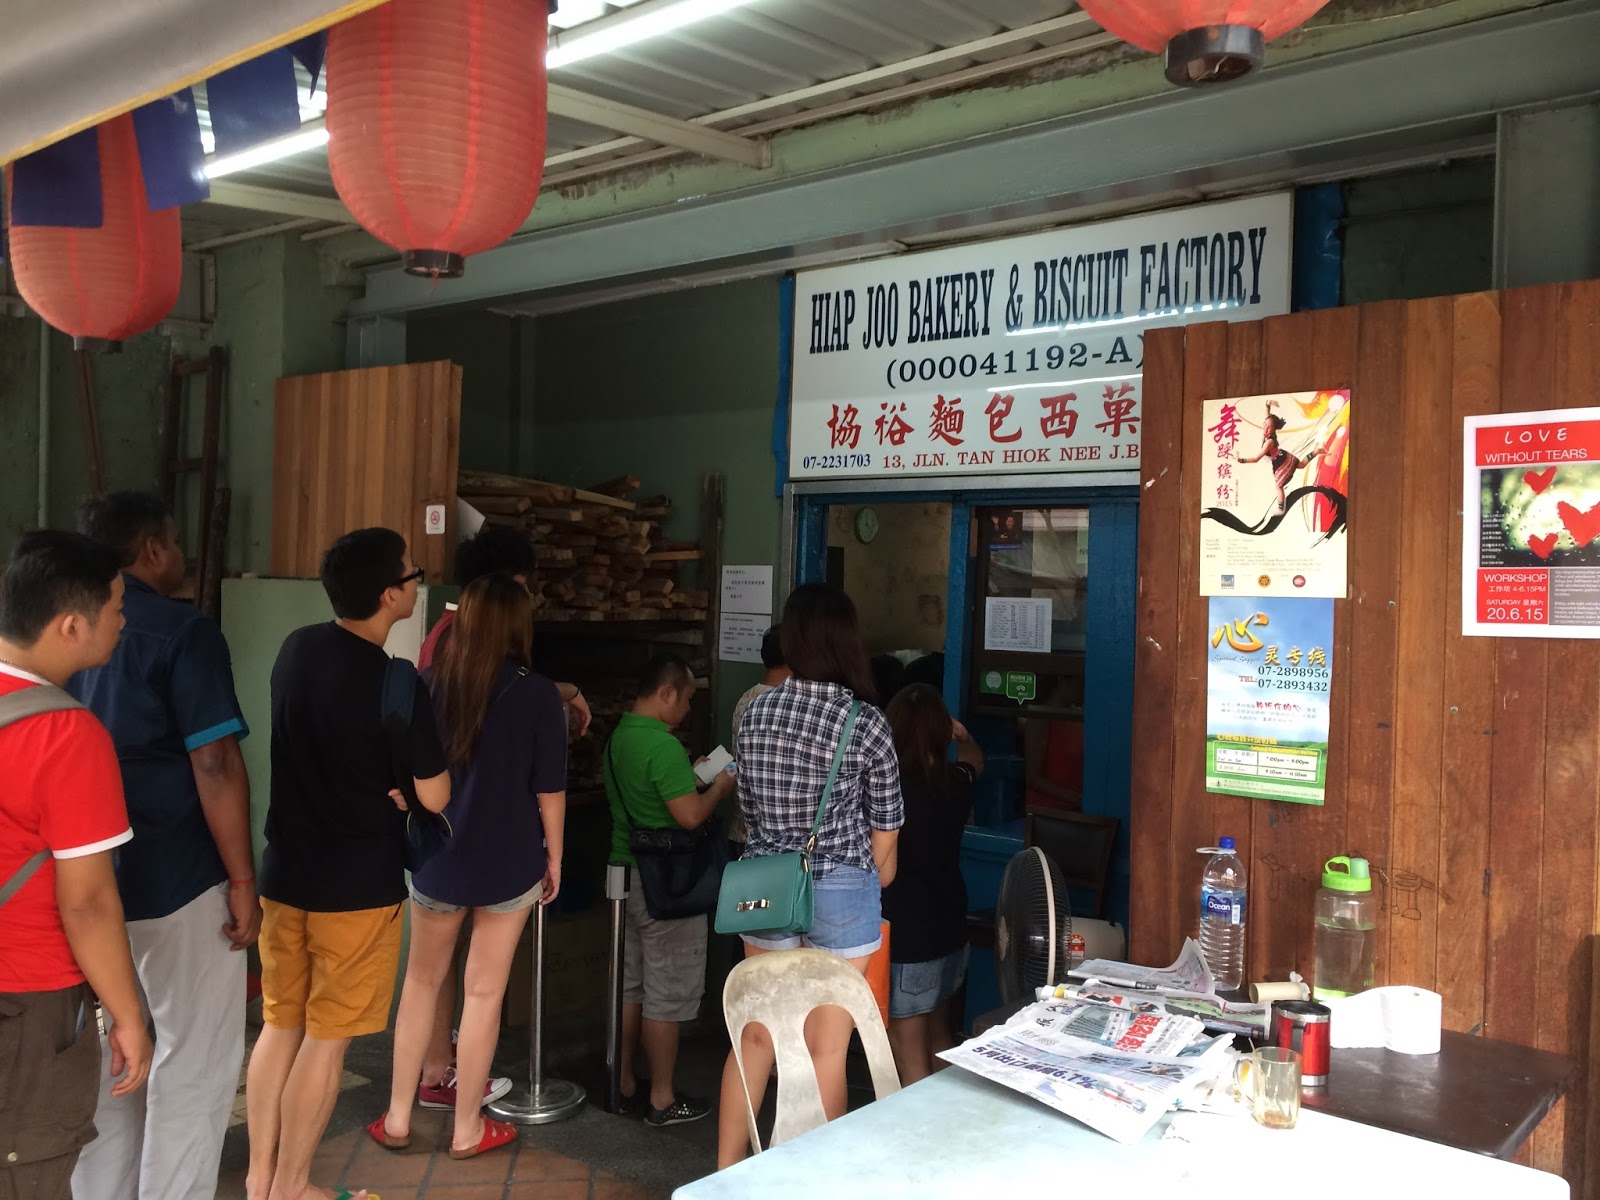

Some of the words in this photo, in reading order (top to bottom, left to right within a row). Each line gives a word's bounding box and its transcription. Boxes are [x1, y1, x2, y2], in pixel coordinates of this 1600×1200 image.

[810, 288, 857, 355] HIAP
[862, 282, 899, 350] JOO
[907, 268, 995, 344] BAKERY
[1005, 263, 1024, 332] &
[1033, 248, 1129, 328] BISCUIT
[1140, 226, 1267, 316] FACTORY
[1504, 428, 1567, 445] LOVE
[802, 453, 871, 469] 07-2231703
[882, 456, 906, 470] 13,
[912, 452, 949, 468] JLN.
[957, 450, 995, 465] TAN
[1002, 447, 1051, 463] HIOK
[1059, 445, 1101, 462] NEE
[1485, 451, 1542, 464] WITHOUT
[1547, 448, 1588, 460] TEARS
[1483, 574, 1547, 583] WORKSHOP
[1487, 607, 1543, 620] 20.6.15
[1239, 675, 1257, 683] TEL:
[1258, 666, 1329, 679] 07-2898956
[1258, 679, 1328, 692] 07-2893432
[1208, 901, 1230, 911] Ocean
